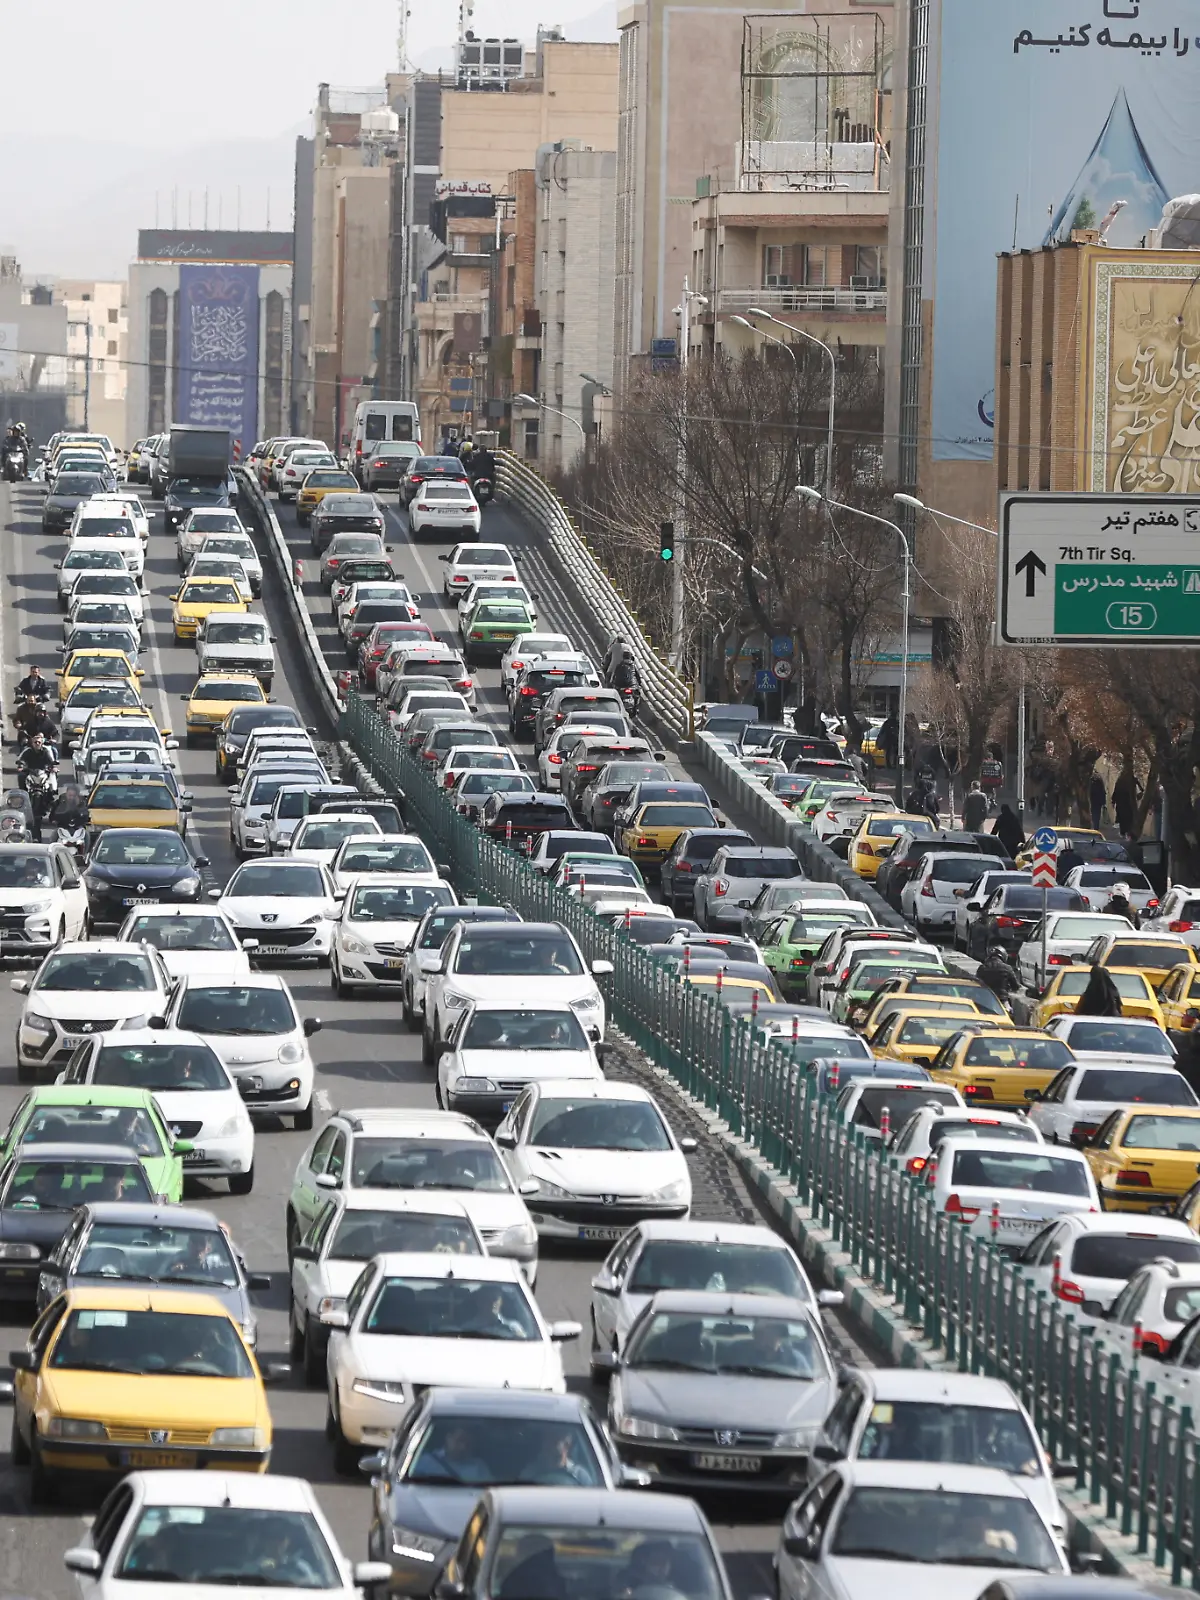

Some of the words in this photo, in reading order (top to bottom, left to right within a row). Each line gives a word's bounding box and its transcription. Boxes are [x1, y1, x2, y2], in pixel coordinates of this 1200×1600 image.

[1102, 0, 1140, 19] تا
[1013, 23, 1092, 54] کنیم
[1096, 27, 1167, 57] بیمه
[1173, 27, 1189, 57] را
[436, 181, 468, 195] قدیانی
[468, 182, 492, 196] کتاب
[1100, 511, 1130, 531] تیر
[1133, 510, 1179, 534] هفتم
[1059, 546, 1083, 561] 7th
[1086, 546, 1106, 561] Tir
[1110, 546, 1136, 563] Sq.
[1062, 574, 1125, 593] مدرس
[1129, 571, 1179, 592] شهید
[1120, 606, 1143, 625] 15
